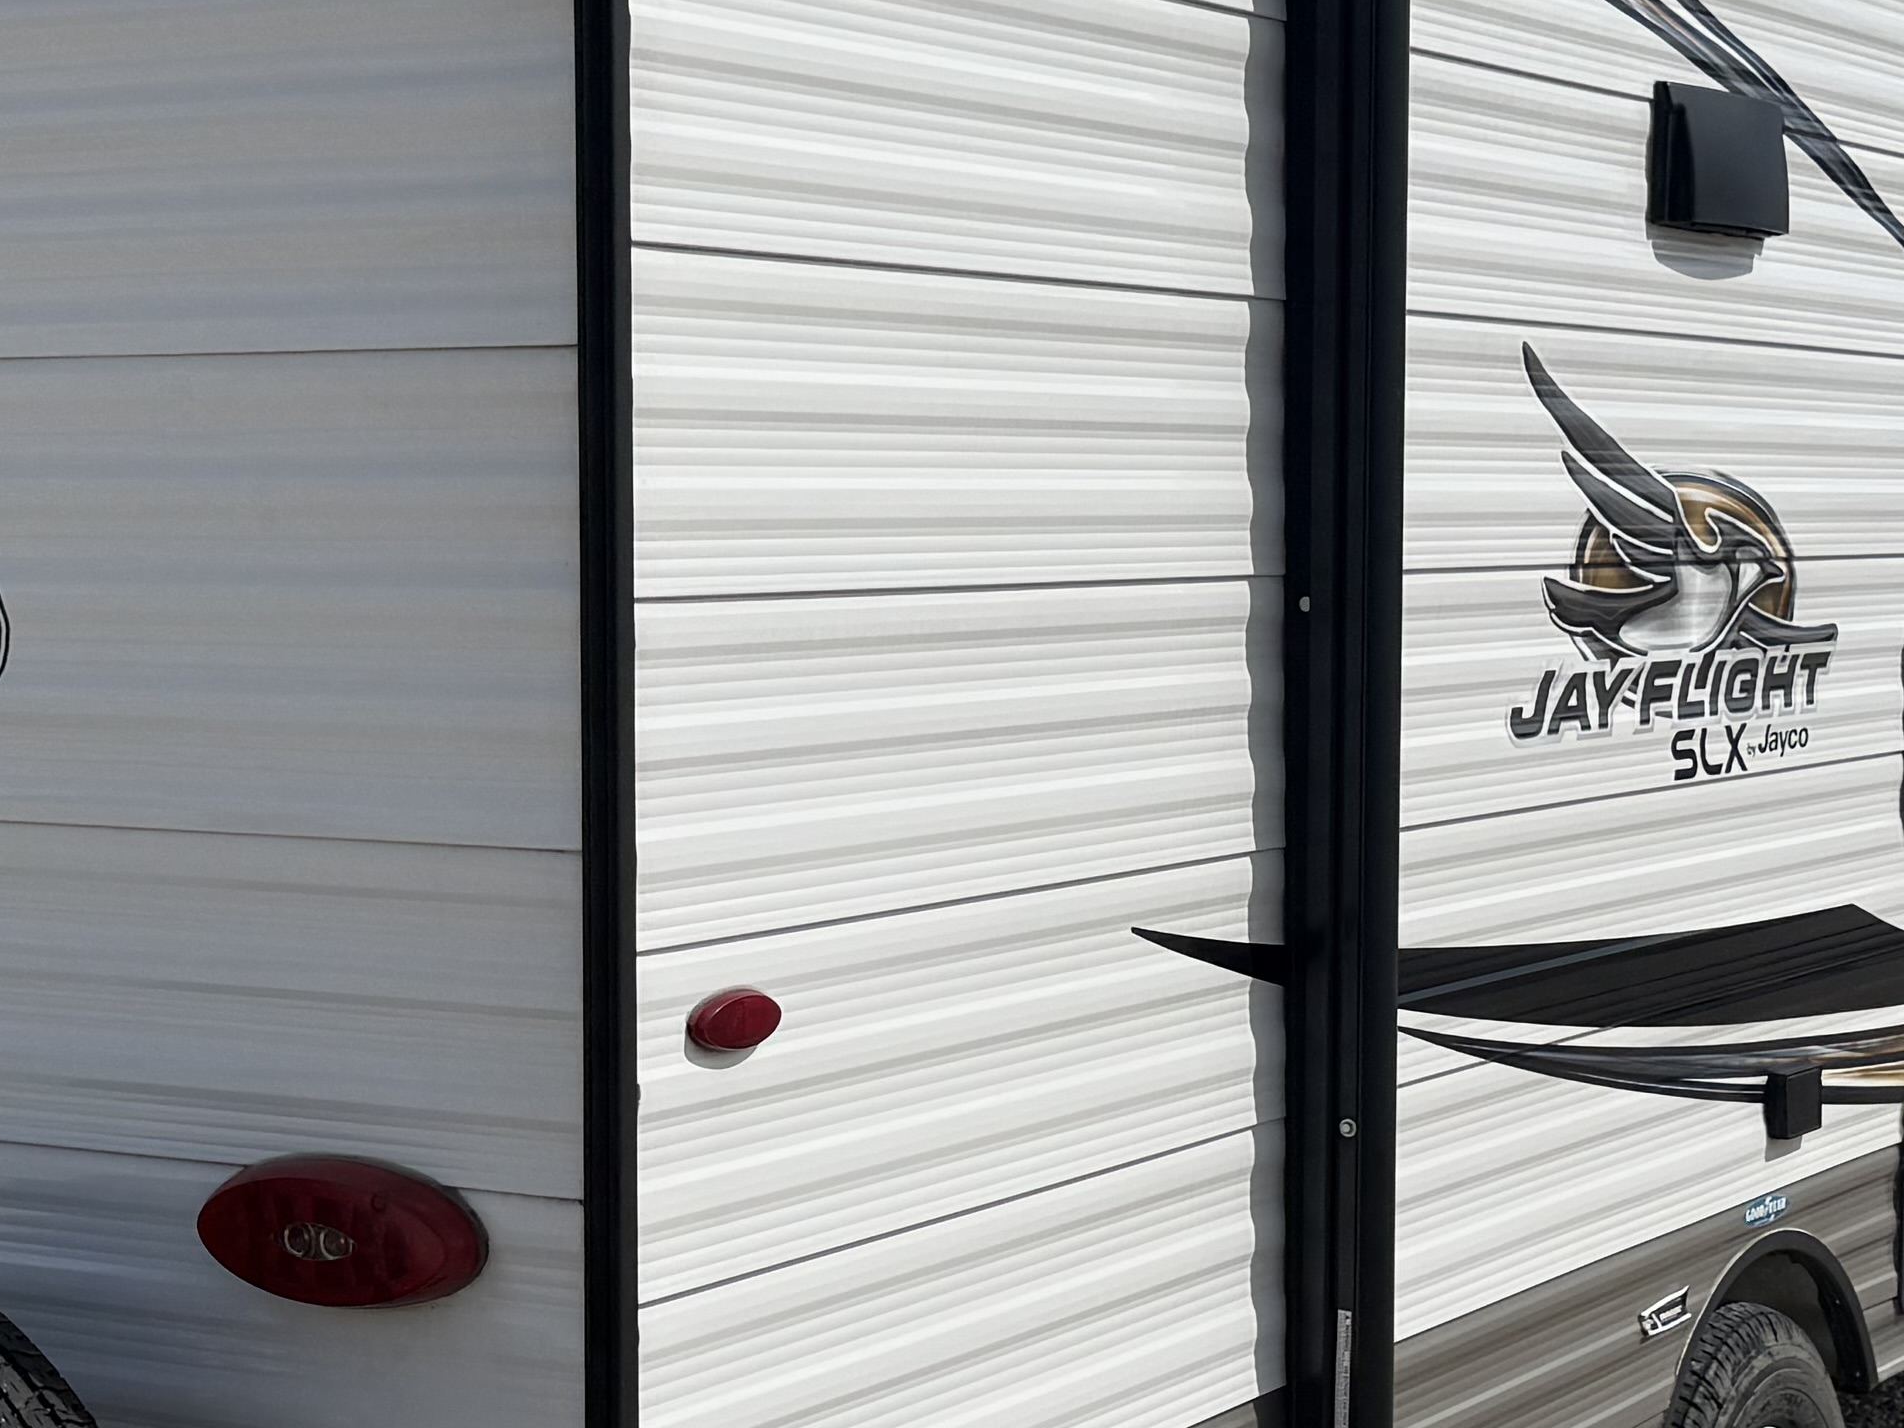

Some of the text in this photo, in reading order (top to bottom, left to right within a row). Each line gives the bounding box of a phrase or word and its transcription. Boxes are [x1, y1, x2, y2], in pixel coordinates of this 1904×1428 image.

[1508, 651, 1833, 740] JAY FLIGHT
[1671, 722, 1748, 781] SLX
[1758, 723, 1809, 757] Jayco
